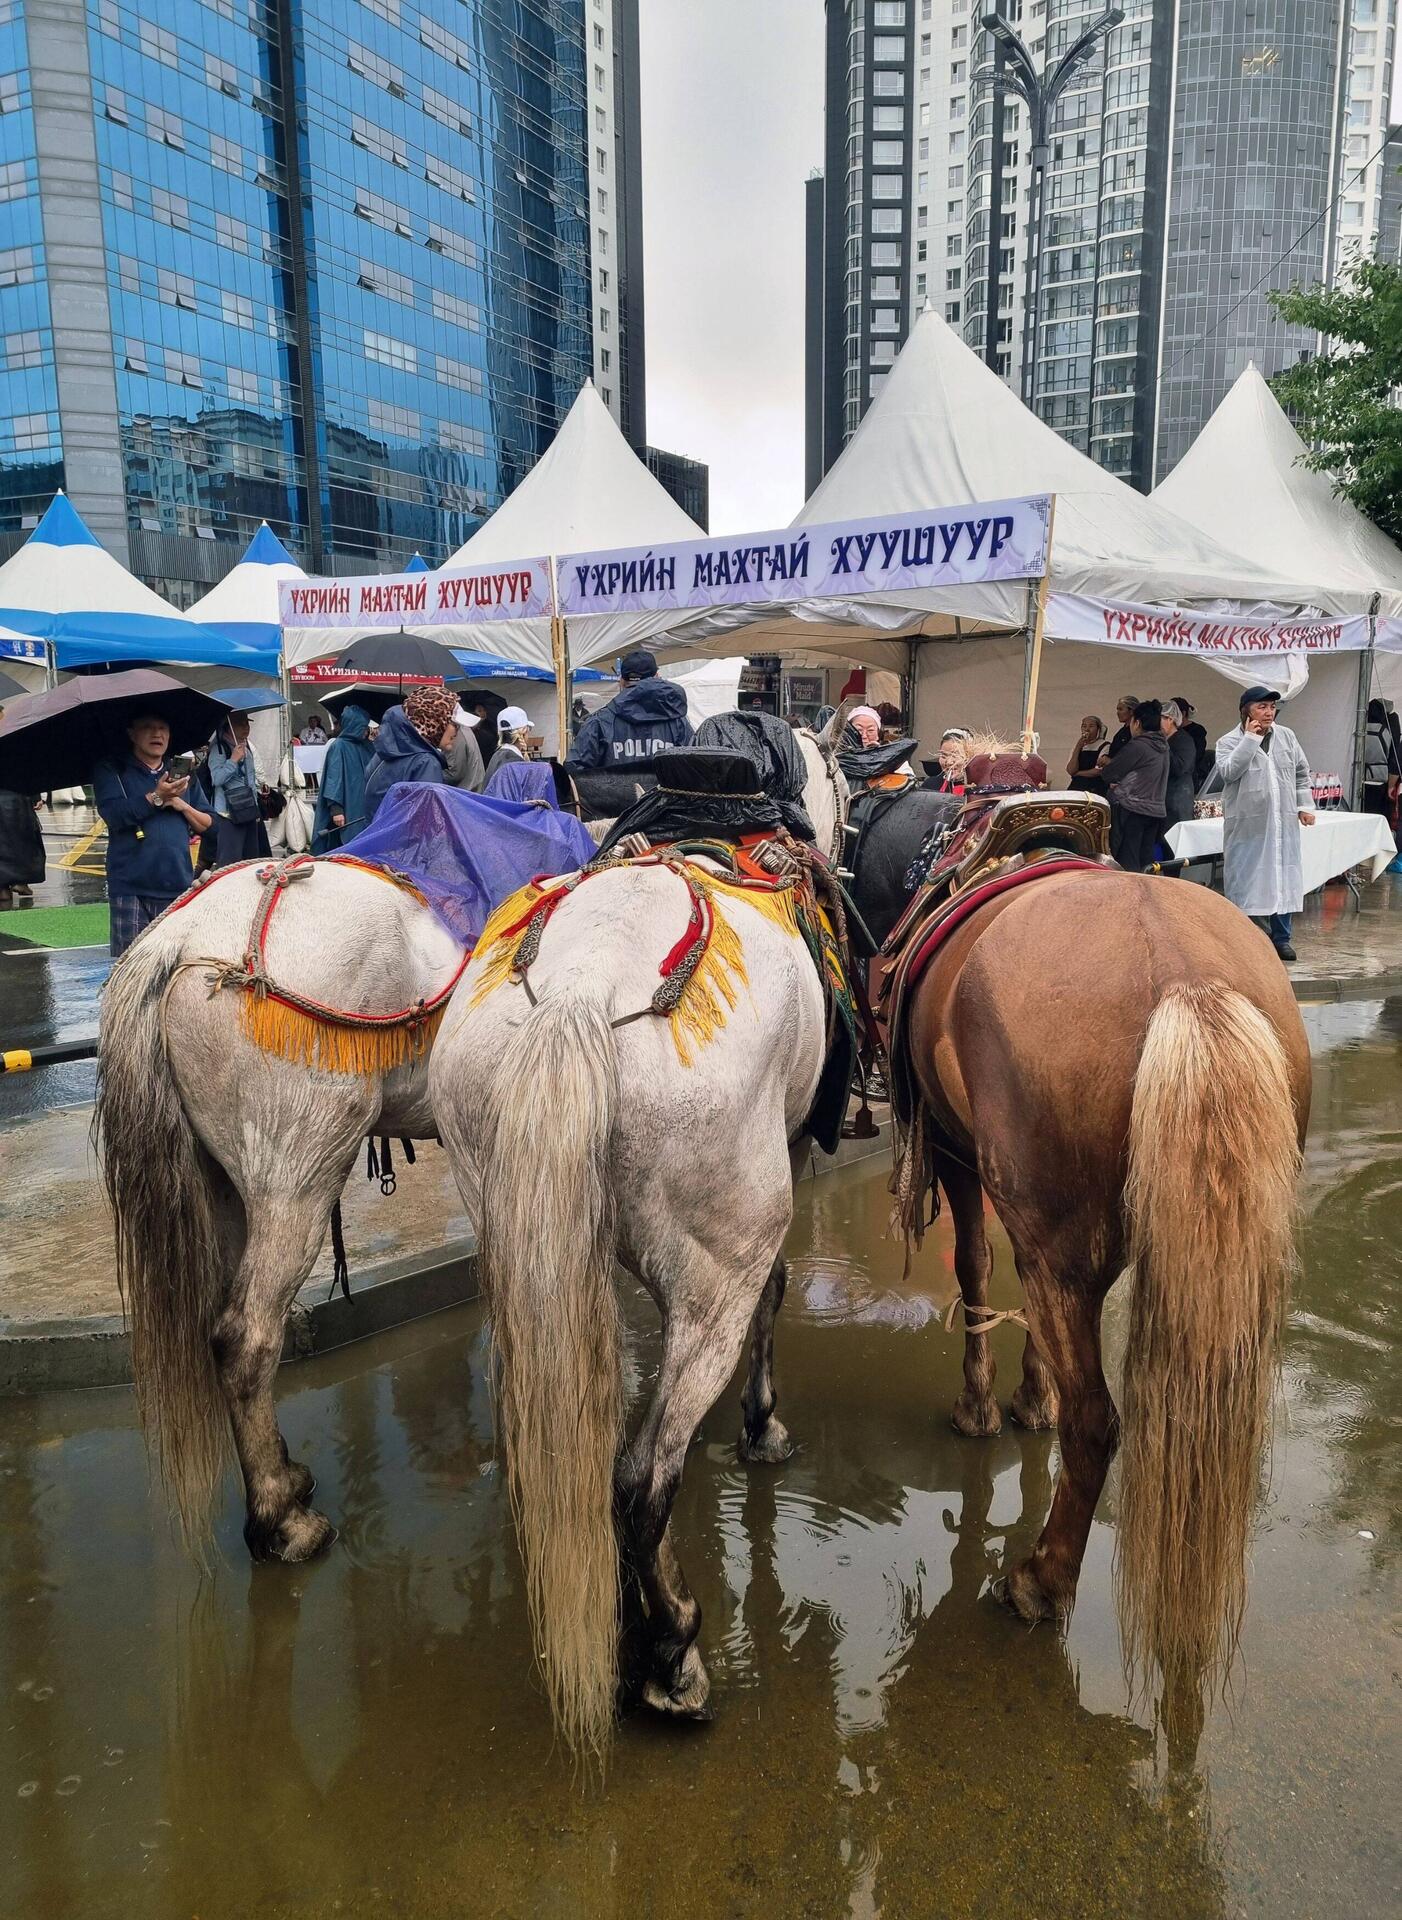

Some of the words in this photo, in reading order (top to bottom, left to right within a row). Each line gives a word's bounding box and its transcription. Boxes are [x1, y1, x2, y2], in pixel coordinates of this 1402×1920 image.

[575, 551, 676, 598] ҮХРИЙН
[693, 533, 810, 588] МАХТАЙ
[830, 516, 1014, 575] ХУУШУУР
[290, 582, 351, 614] ҮХРИЙН
[360, 576, 427, 613] МАХТАЙ
[438, 571, 532, 609] ХУУШУУР
[1102, 609, 1198, 647] ҮХРИЙН
[1197, 620, 1281, 651] МАХТАЙ
